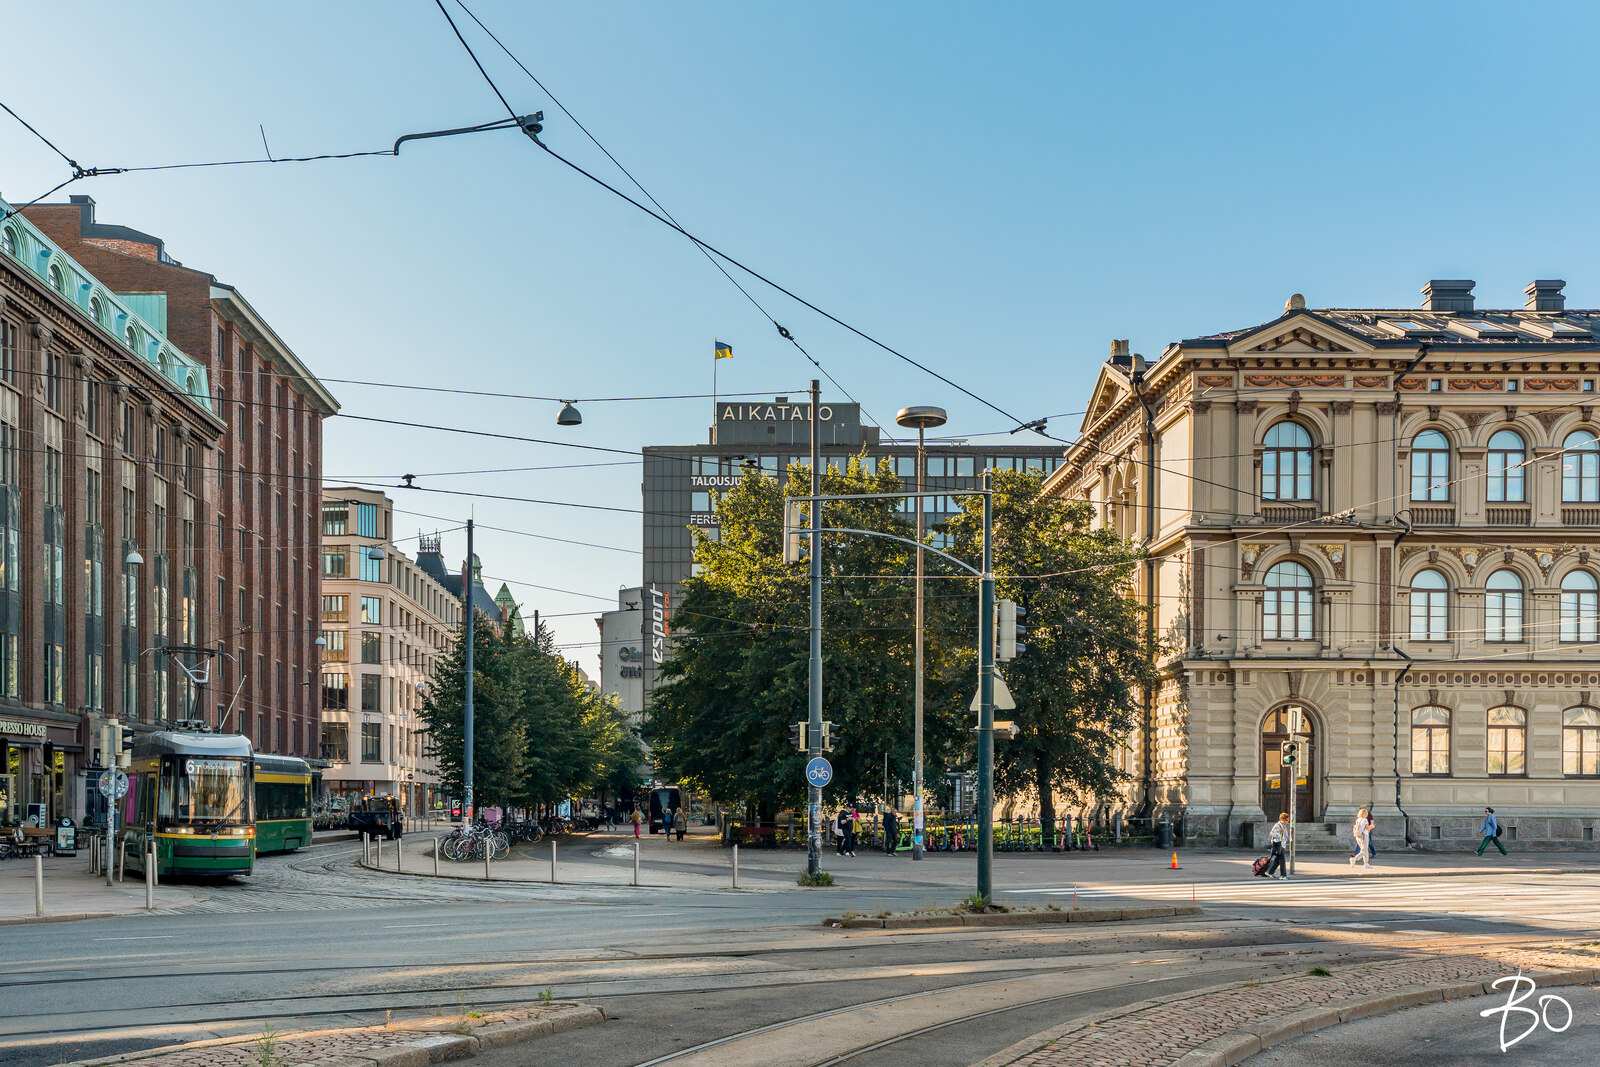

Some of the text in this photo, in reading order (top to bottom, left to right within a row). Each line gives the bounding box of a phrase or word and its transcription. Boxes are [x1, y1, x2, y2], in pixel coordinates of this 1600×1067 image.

[722, 406, 834, 421] AIKATALO
[649, 582, 666, 664] esport
[23, 723, 47, 737] HOUSE
